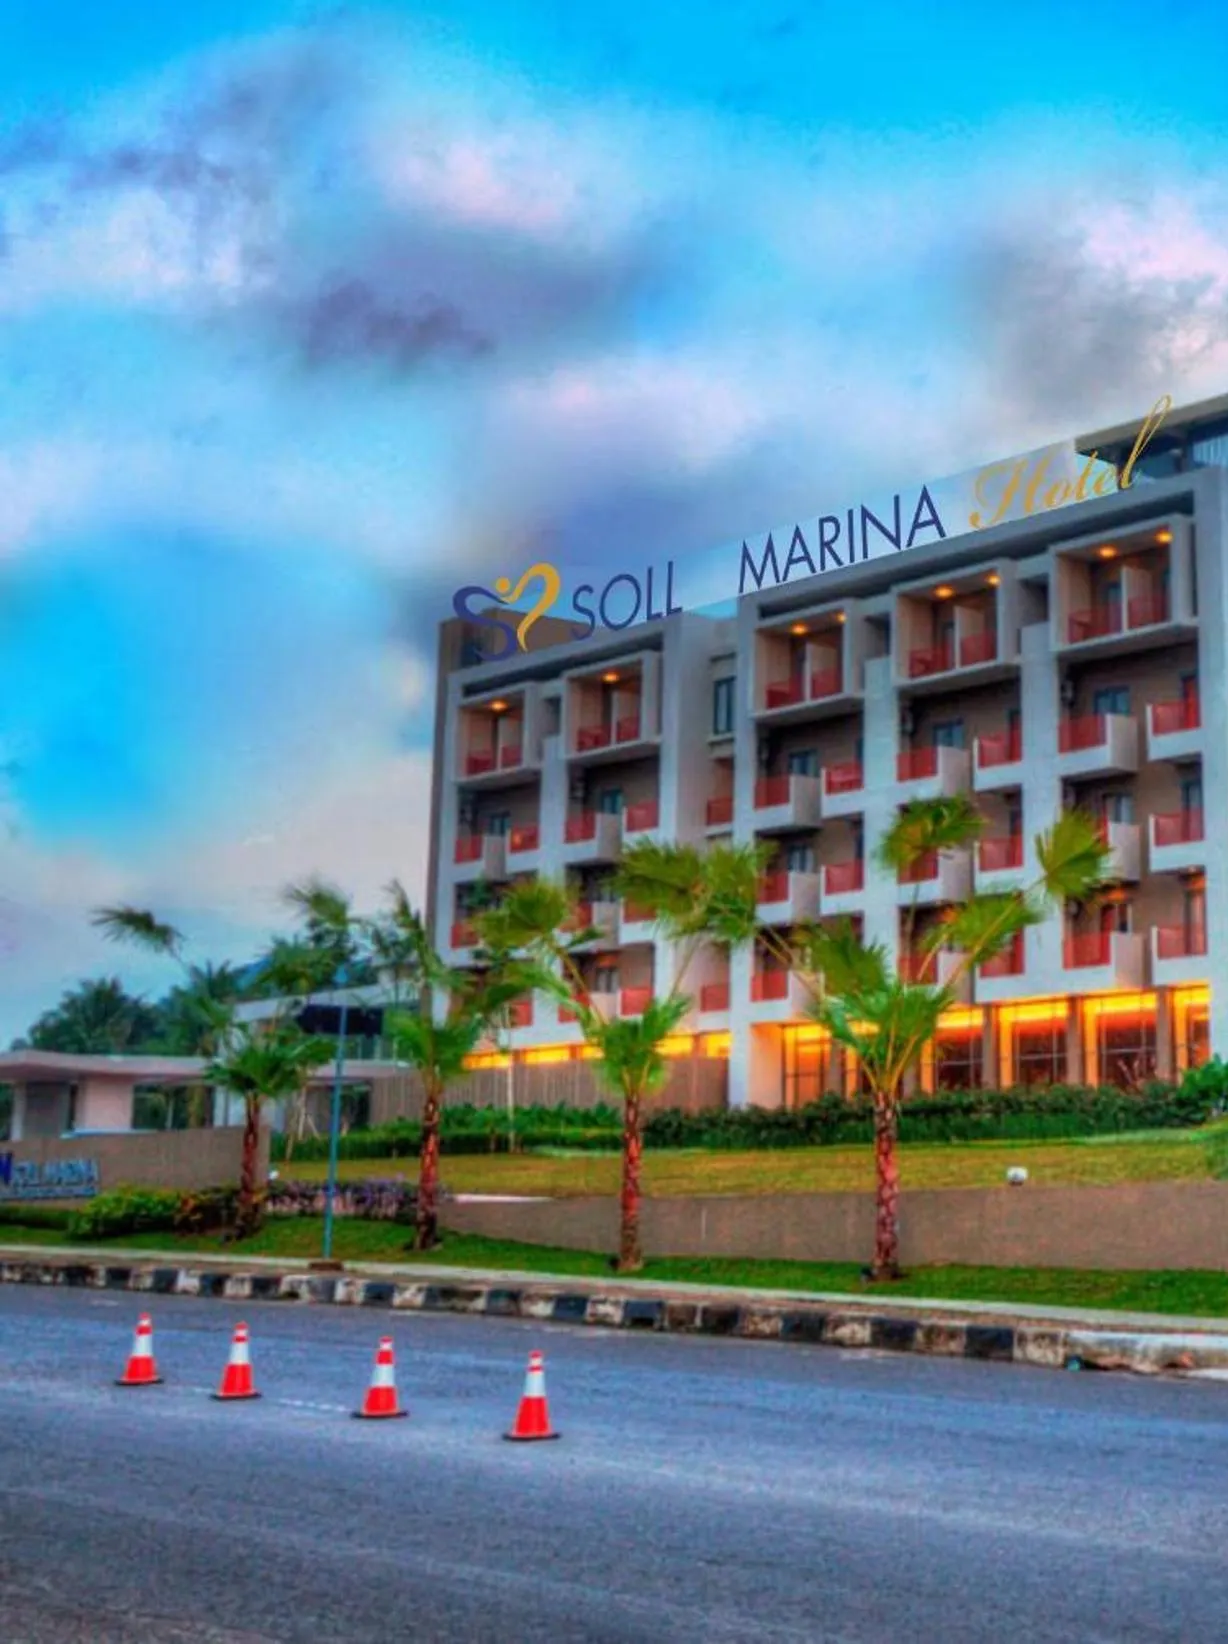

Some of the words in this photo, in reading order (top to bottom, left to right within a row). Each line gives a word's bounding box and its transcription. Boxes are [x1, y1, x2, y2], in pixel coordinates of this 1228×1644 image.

[573, 561, 683, 640] SOLL
[739, 484, 946, 594] MARINA
[969, 394, 1172, 529] Hotel
